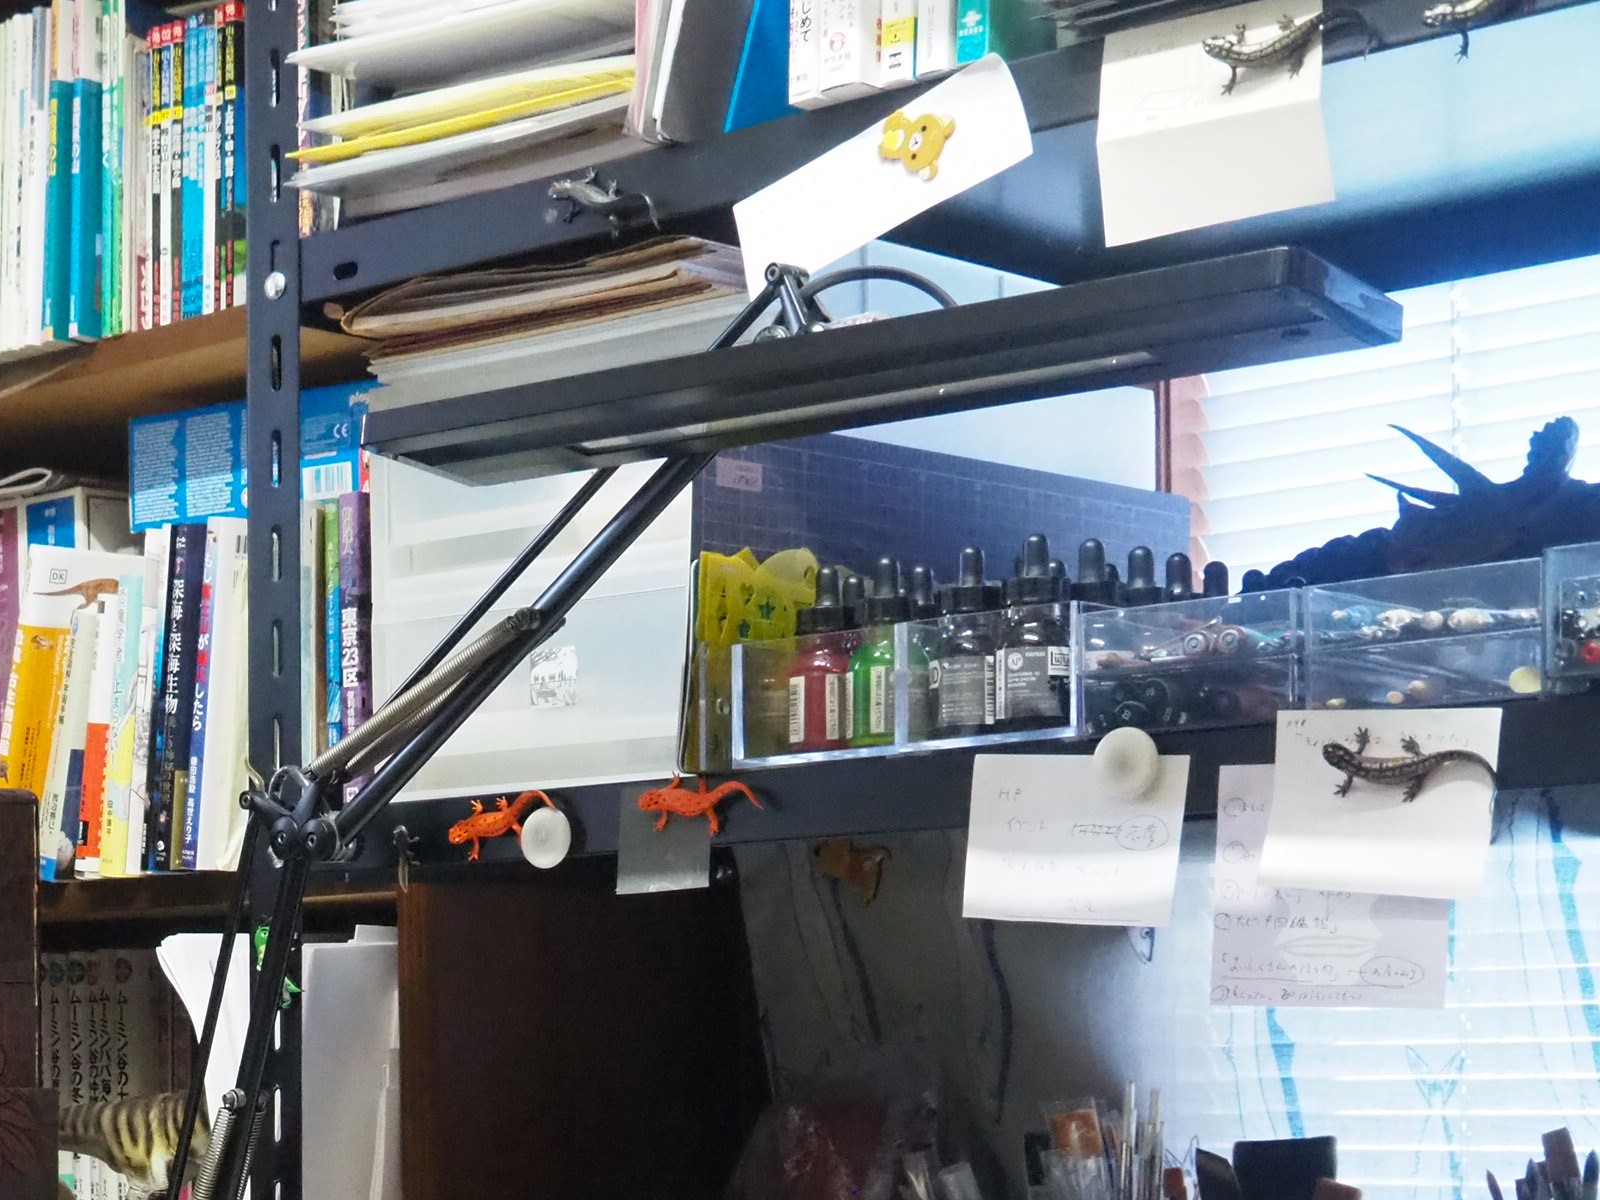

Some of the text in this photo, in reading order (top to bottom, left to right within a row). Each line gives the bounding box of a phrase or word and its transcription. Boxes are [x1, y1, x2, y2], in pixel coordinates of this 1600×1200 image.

[165, 579, 185, 715] 深海と深海生物
[341, 607, 359, 688] 東京23区
[70, 989, 83, 1104] ムーミン谷の冬
